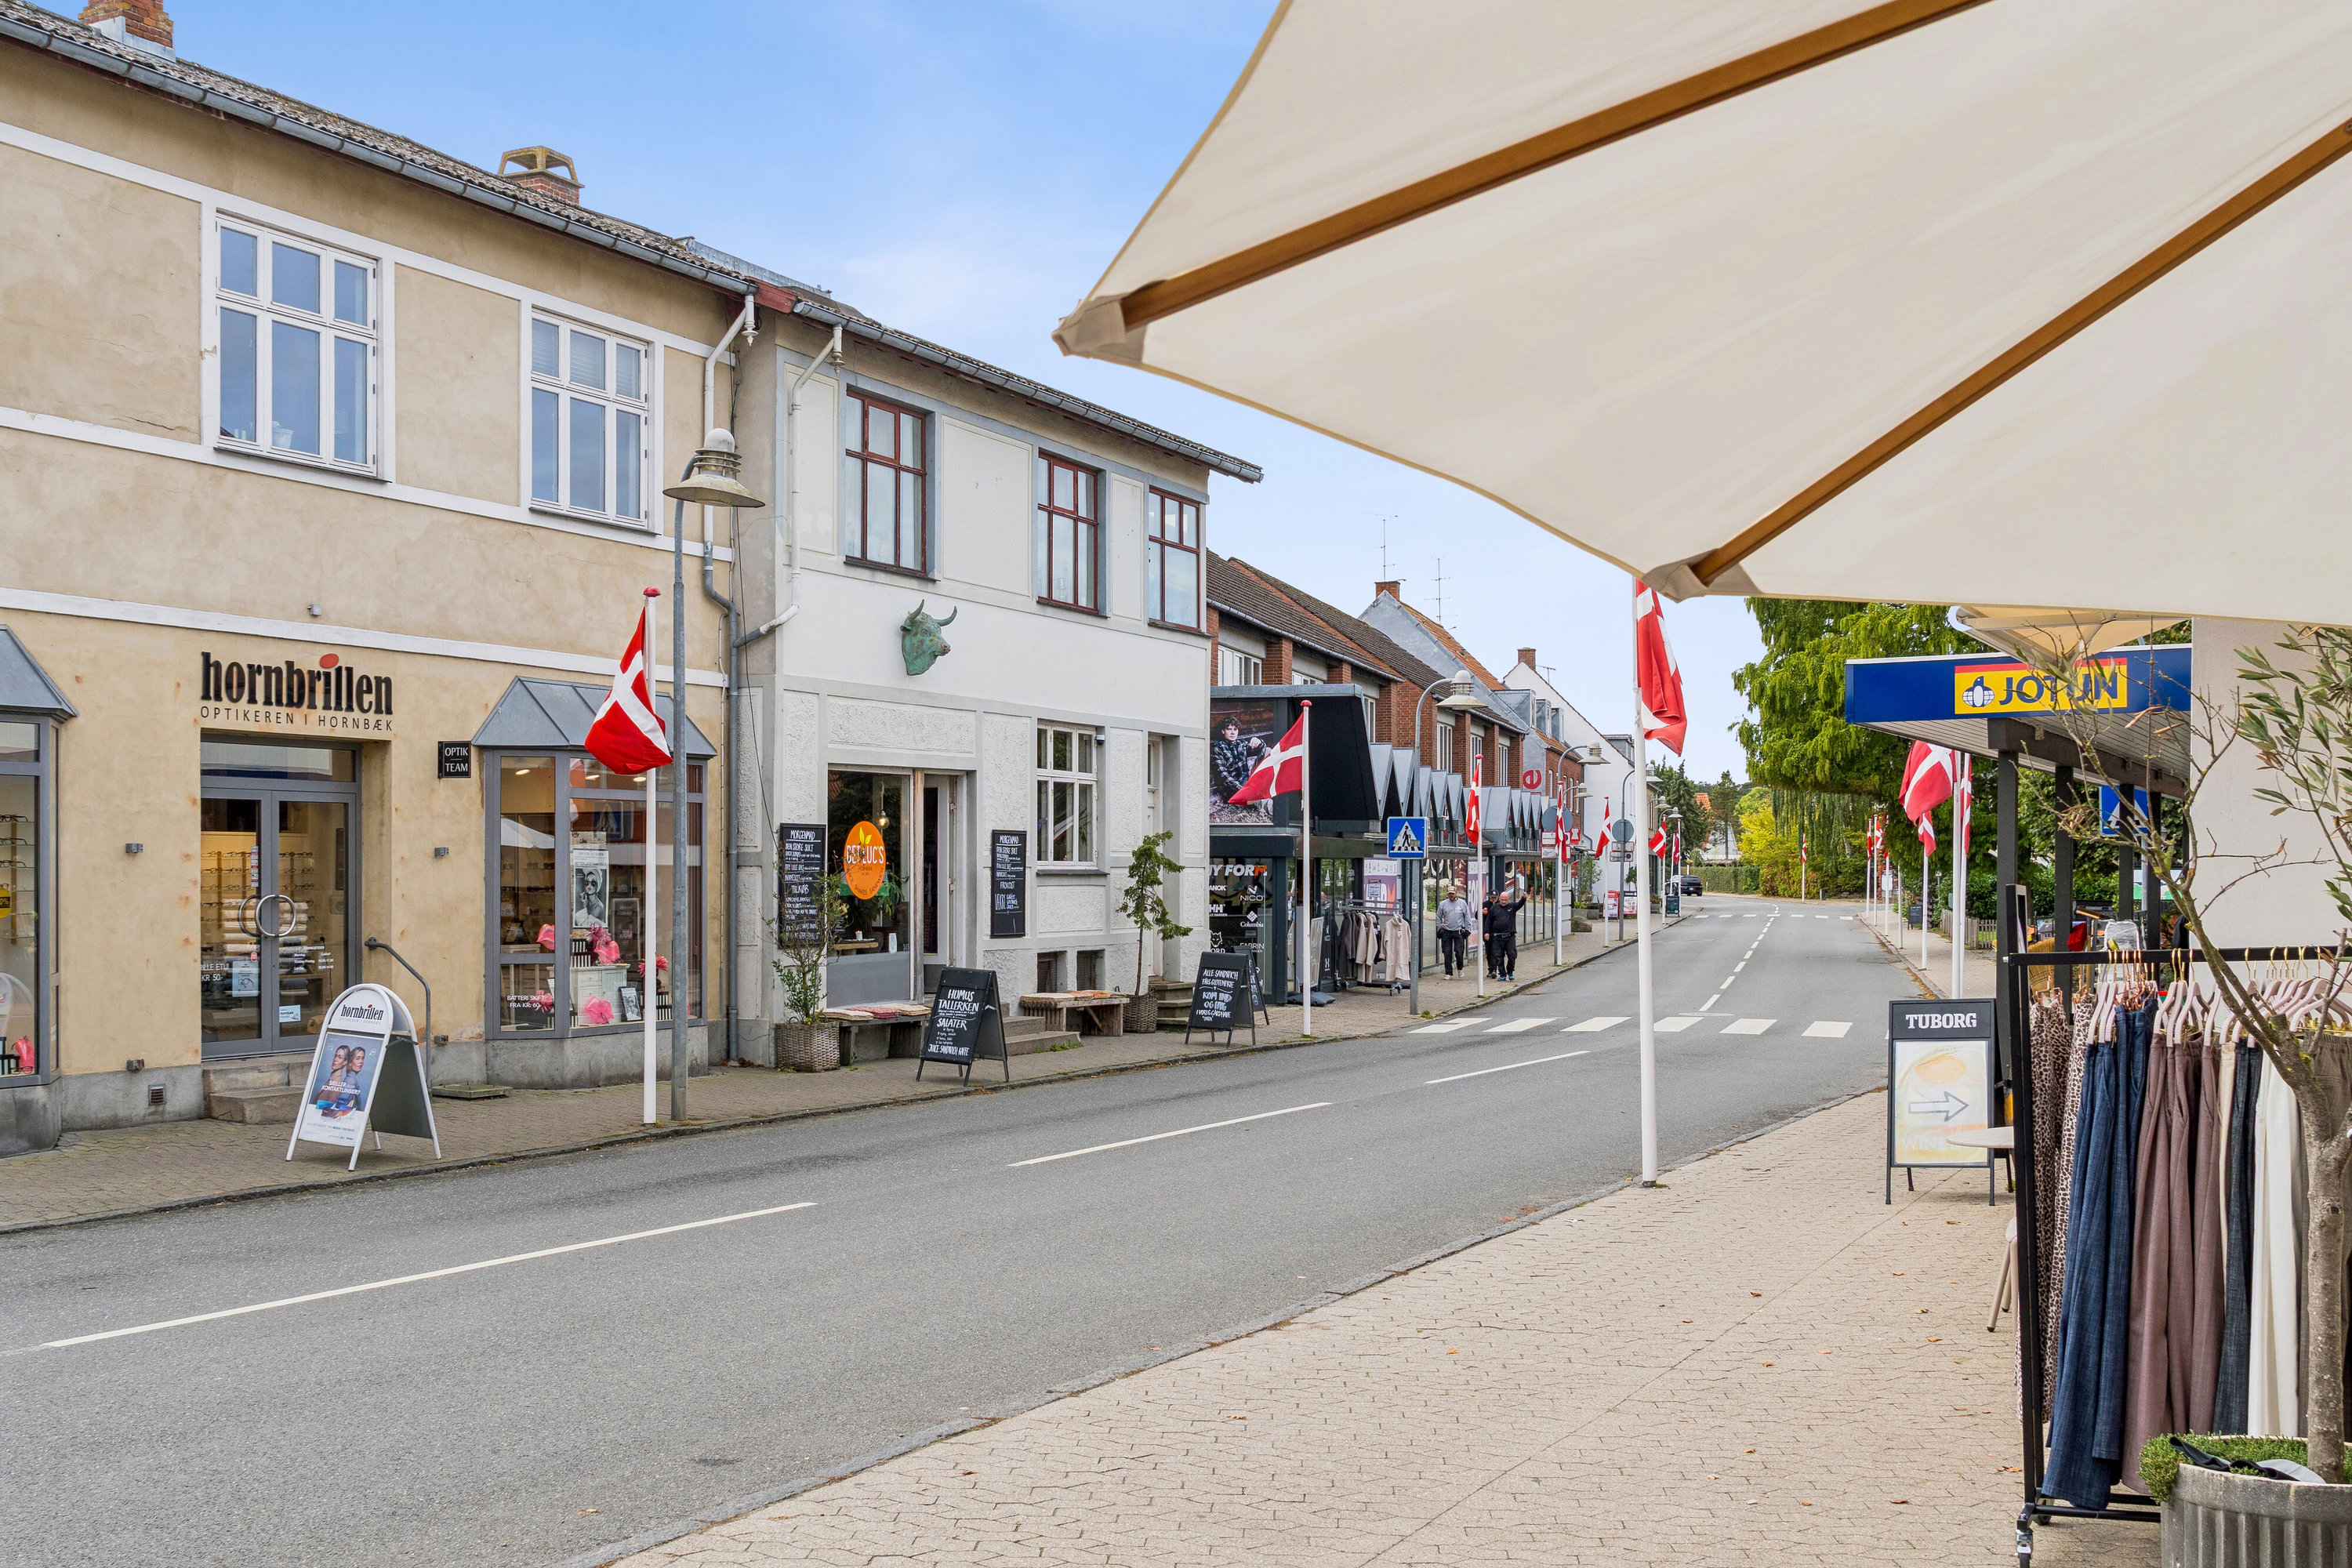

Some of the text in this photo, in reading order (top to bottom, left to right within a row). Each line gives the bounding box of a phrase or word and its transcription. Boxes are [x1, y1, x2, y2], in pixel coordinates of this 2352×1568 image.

[201, 652, 393, 714] hornbrillen
[201, 706, 393, 731] OPTIKEREN I HORNBÆK
[445, 747, 469, 757] OPTIK
[445, 763, 469, 772] TEAM
[1203, 969, 1239, 981] ALLE SANDWICH
[948, 989, 975, 1002] HUMUS
[1203, 992, 1218, 1001] KOM
[938, 1000, 979, 1012] TALLERKEN
[1203, 1000, 1214, 1009] OG
[341, 1004, 383, 1021] hornbrillen
[937, 1018, 967, 1031] SALATER
[1906, 1013, 1976, 1029] TUBORG
[928, 1044, 939, 1053] JUICE
